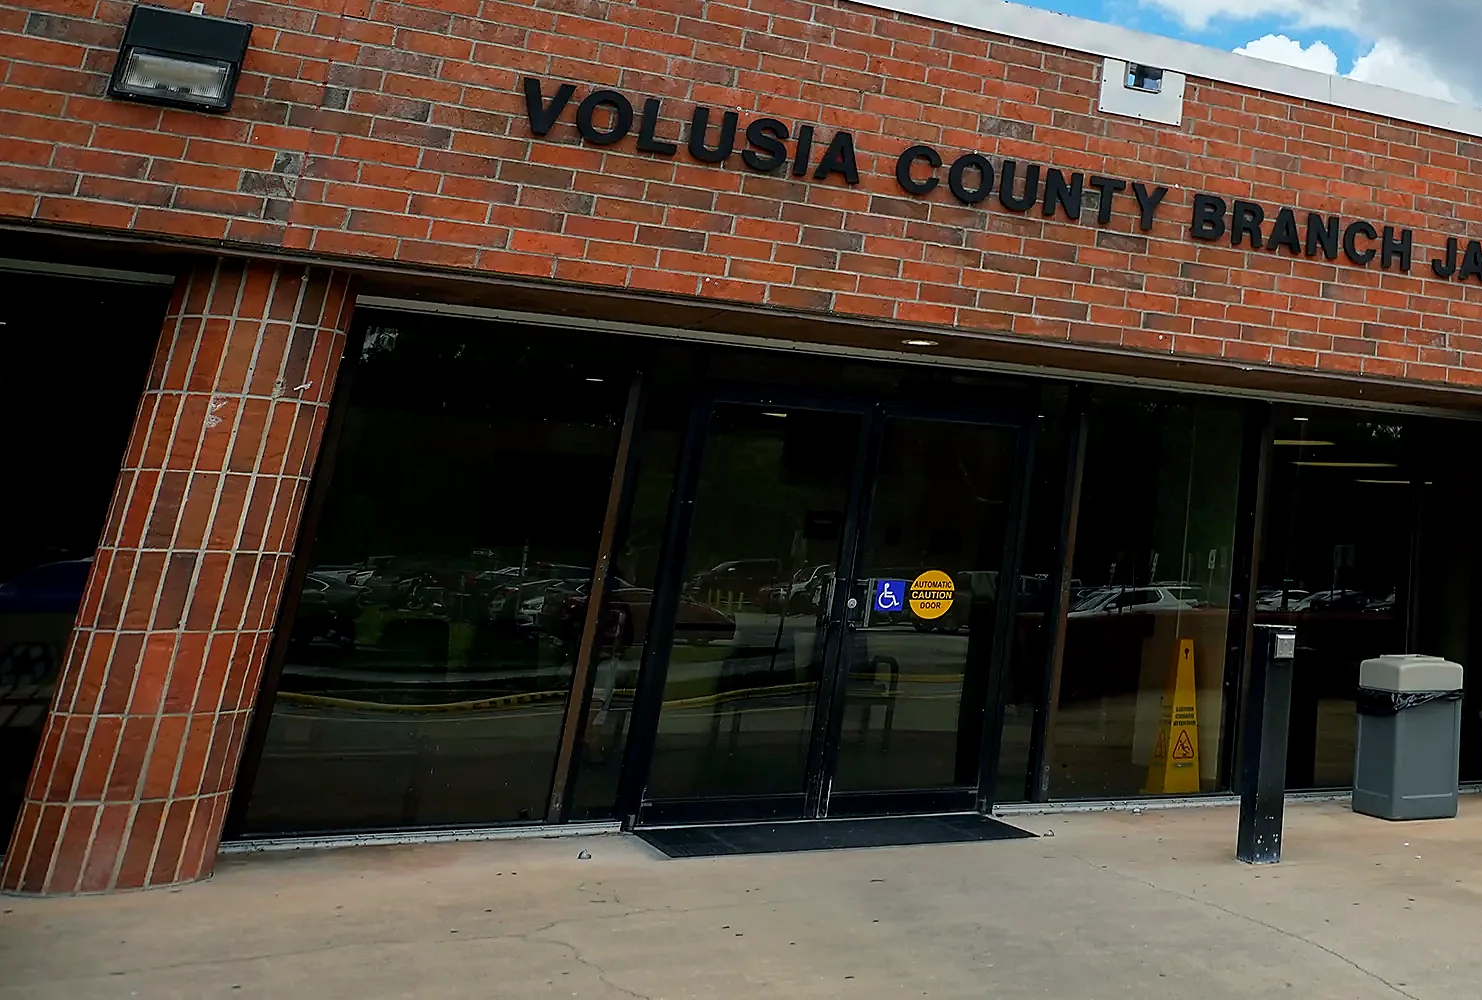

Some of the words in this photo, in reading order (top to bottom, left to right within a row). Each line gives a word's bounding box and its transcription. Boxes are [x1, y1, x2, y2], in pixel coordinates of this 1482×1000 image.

[521, 76, 860, 185] VOLUSIA
[895, 144, 1169, 232] COUNTY
[1189, 193, 1413, 275] BRANCH
[914, 581, 952, 589] AUTOMATIC
[912, 591, 953, 599] CAUTION
